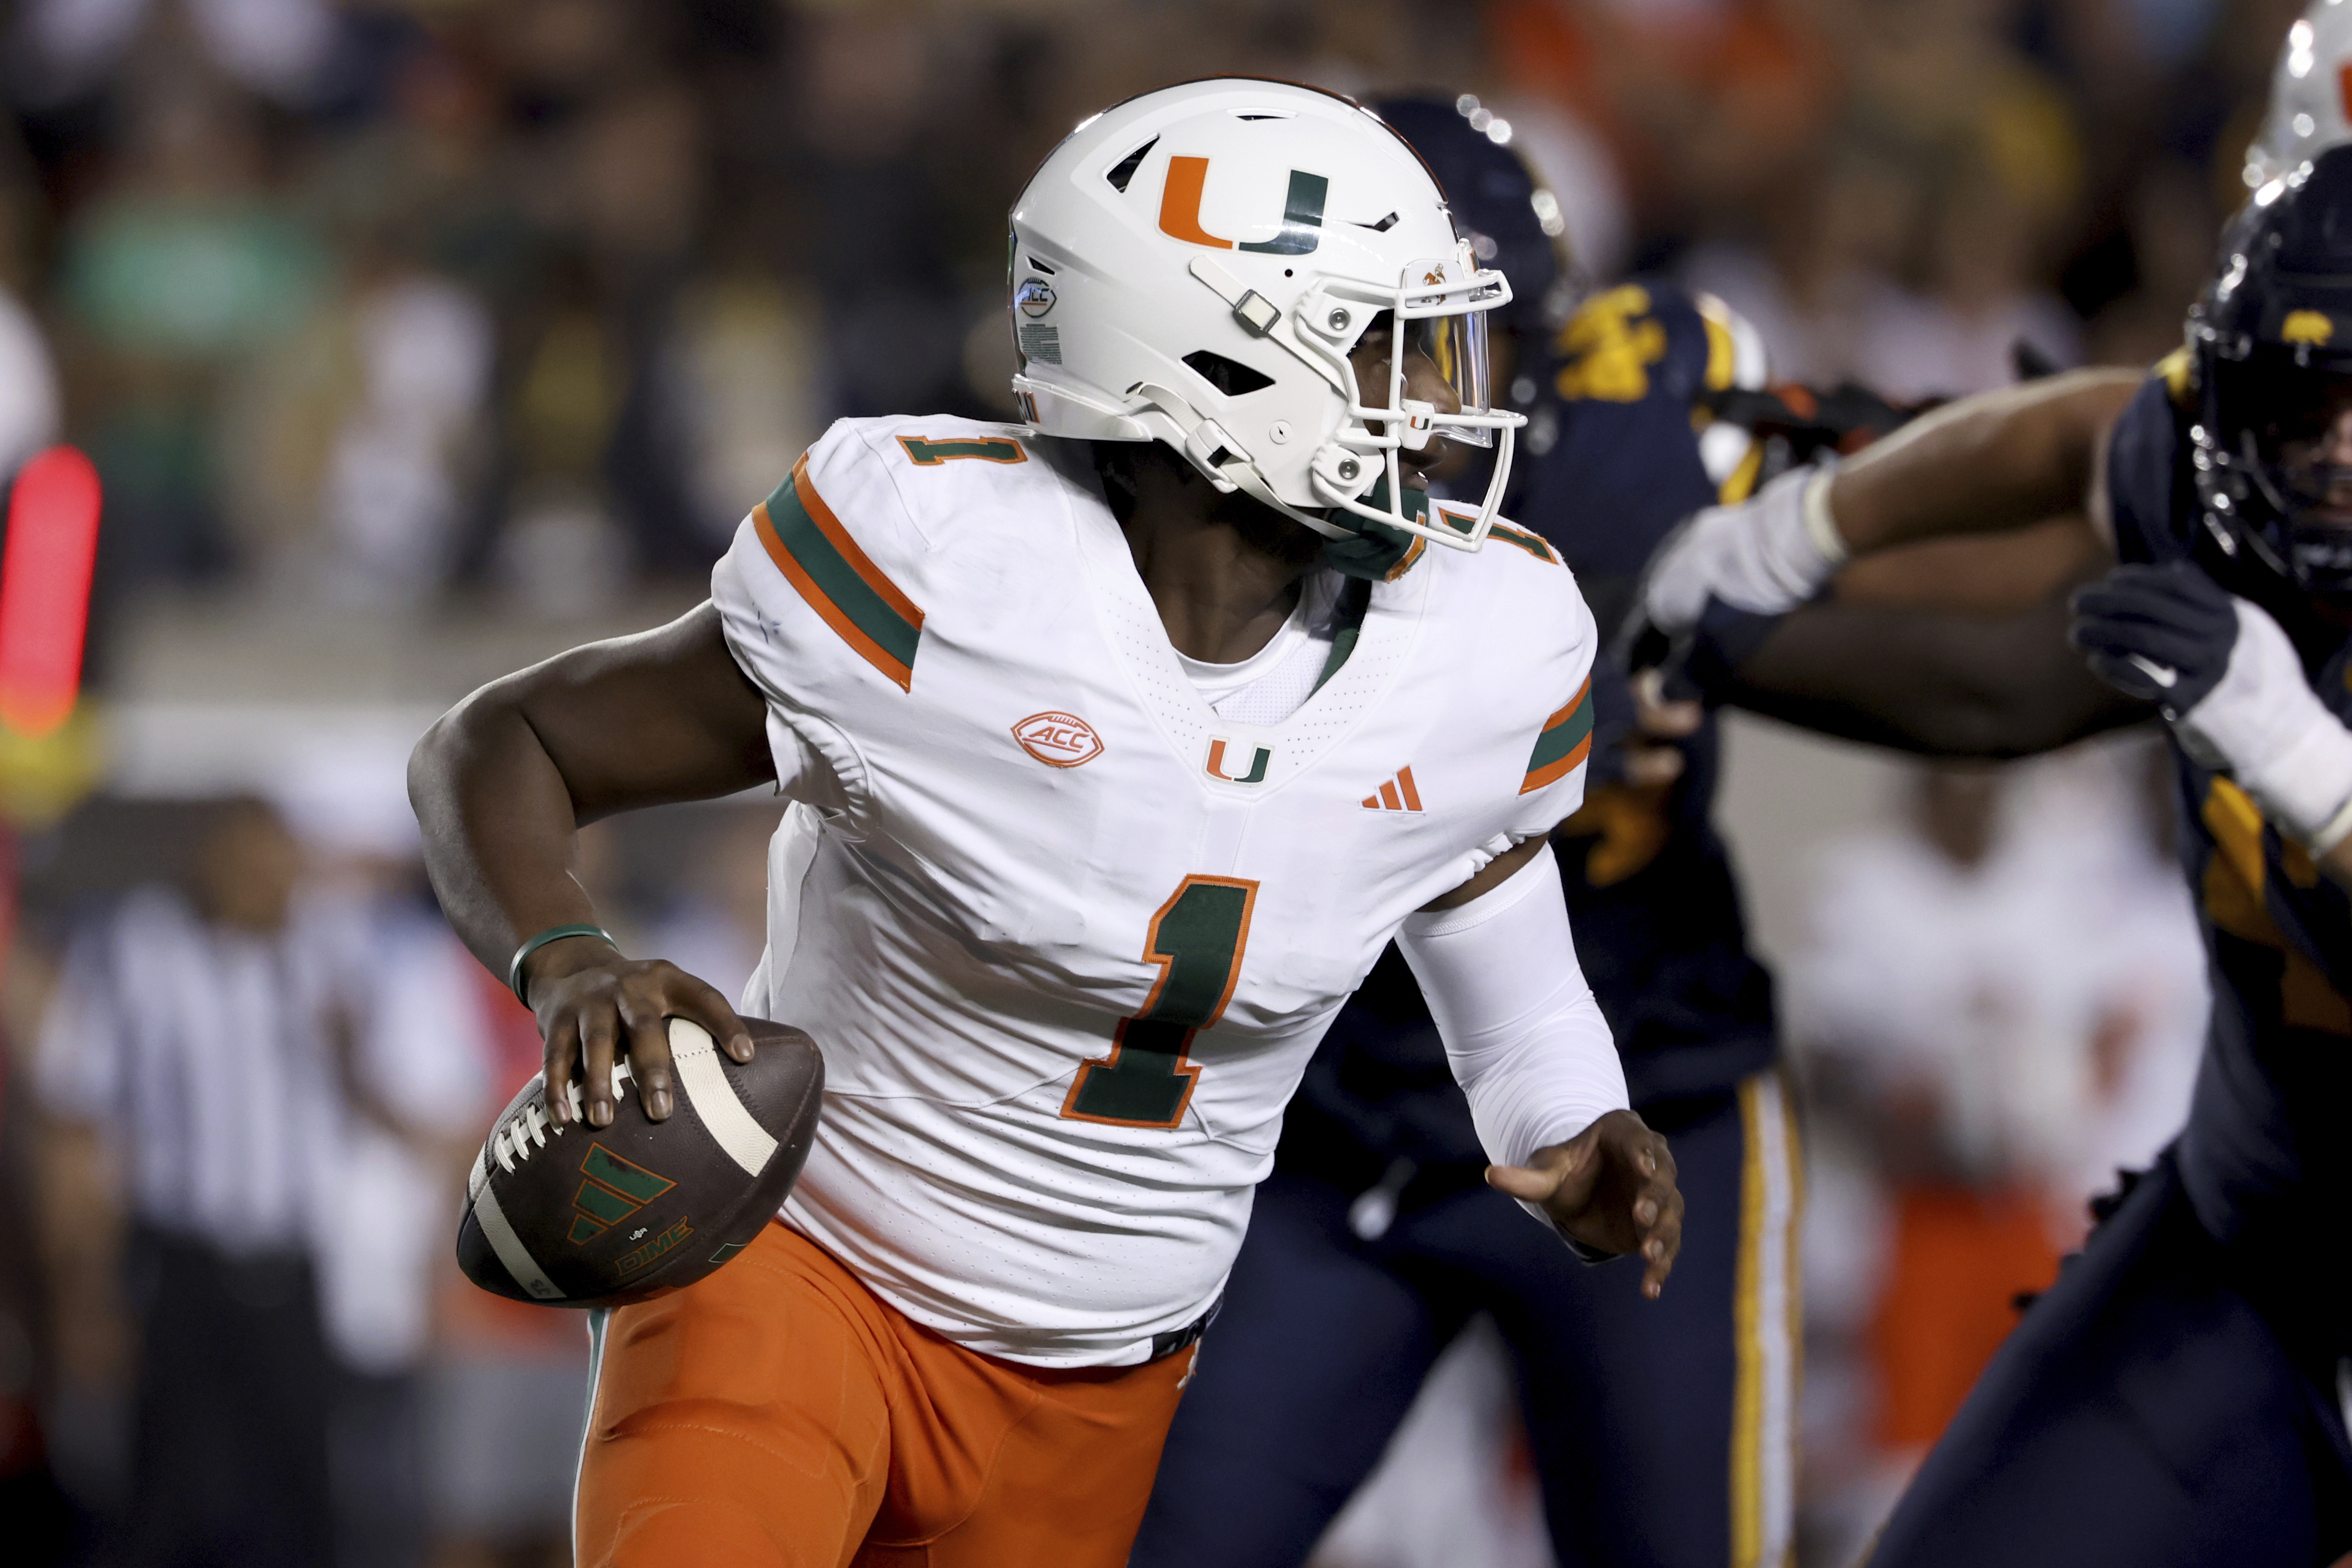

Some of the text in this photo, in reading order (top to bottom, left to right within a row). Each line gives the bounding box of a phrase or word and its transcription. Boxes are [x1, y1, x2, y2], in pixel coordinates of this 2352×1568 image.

[1158, 156, 1328, 256] U
[1410, 416, 1430, 430] U
[895, 436, 1028, 466] 1
[1028, 726, 1090, 748] ACC
[1206, 738, 1271, 783] U
[1060, 873, 1260, 1128] 1
[614, 1215, 694, 1276] DIME
[629, 1228, 648, 1240] USA
